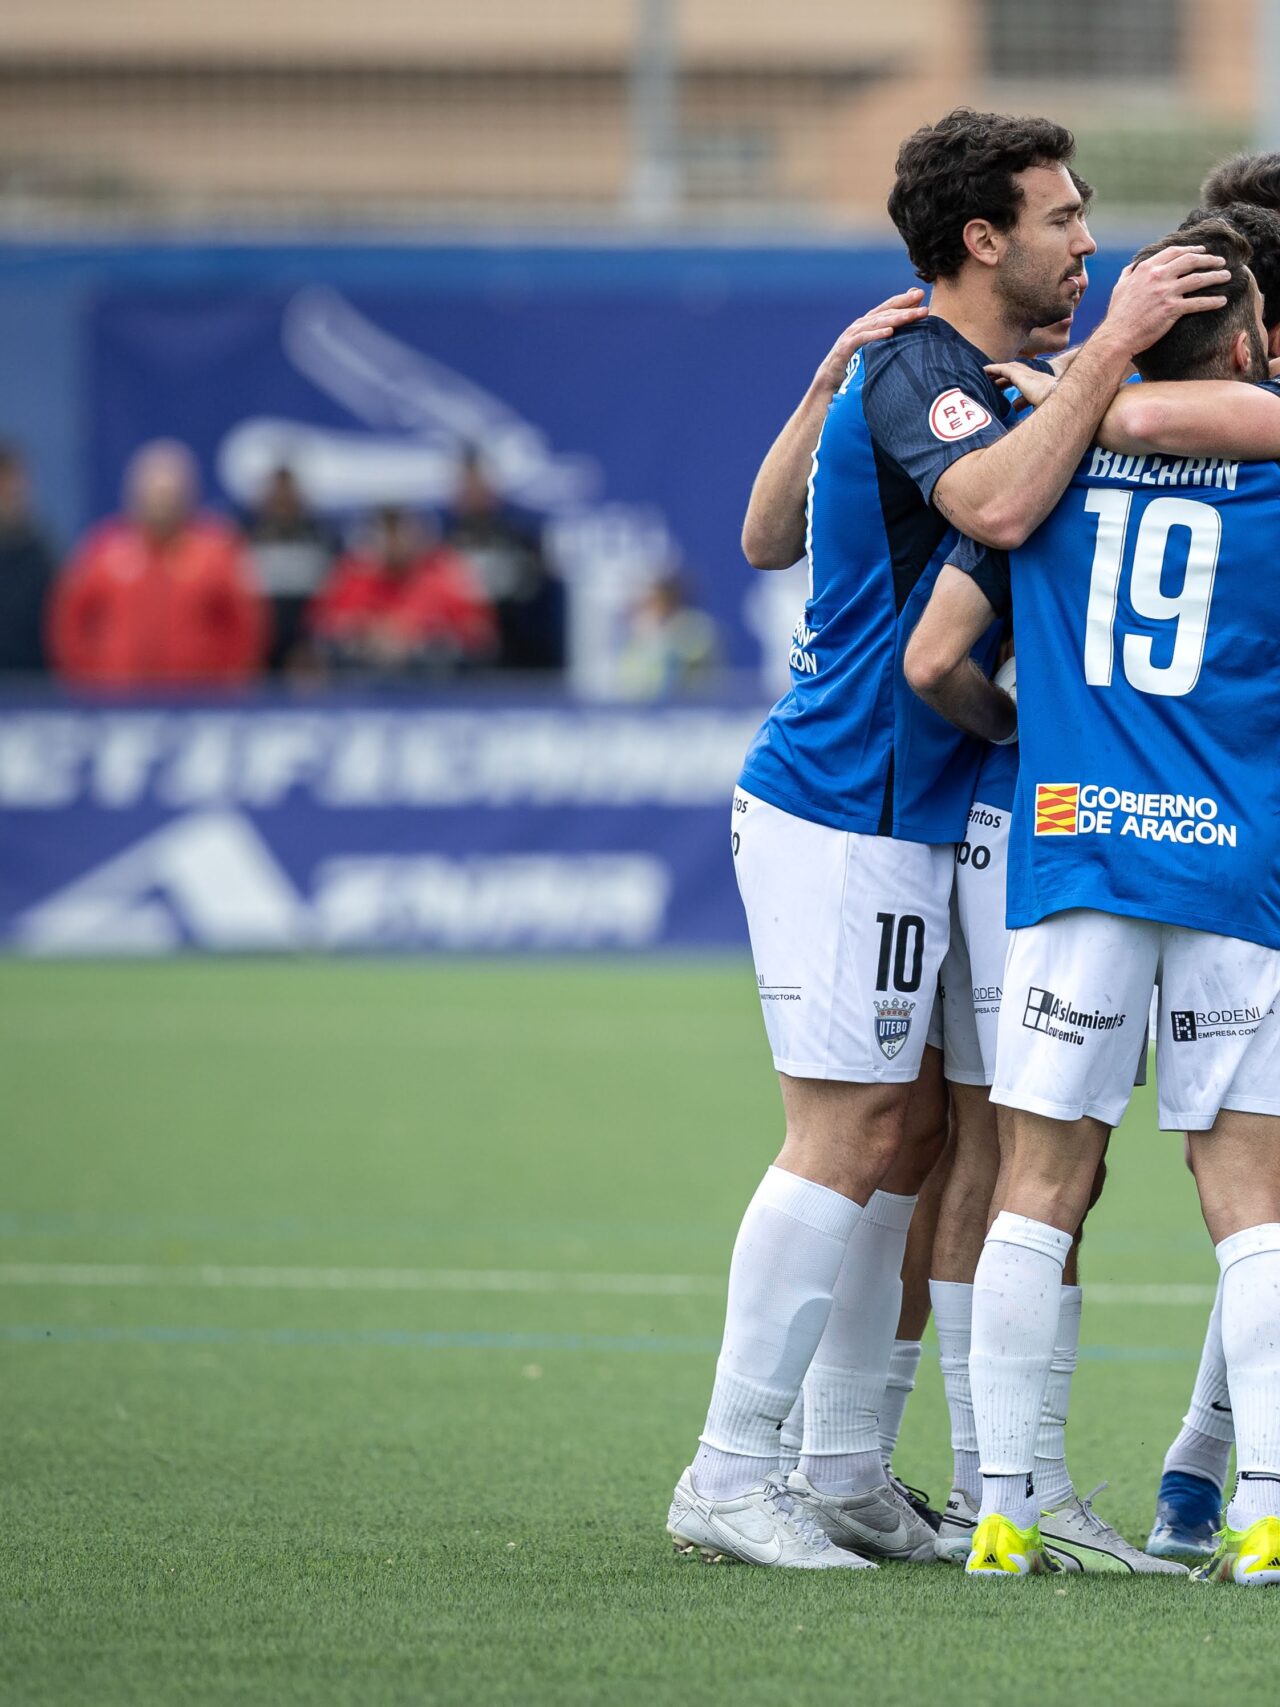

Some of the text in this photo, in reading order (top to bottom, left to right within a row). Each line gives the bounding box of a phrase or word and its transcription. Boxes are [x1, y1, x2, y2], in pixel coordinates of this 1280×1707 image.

[1083, 487, 1222, 697] 19
[1079, 784, 1218, 820] GOBIERNO
[1078, 811, 1237, 847] DE ARAGON
[875, 912, 926, 993] 10
[879, 1020, 908, 1037] UTEBO
[1195, 1006, 1261, 1025] RODENI
[1197, 1029, 1237, 1039] EMPRESA
[887, 1044, 897, 1056] FC
